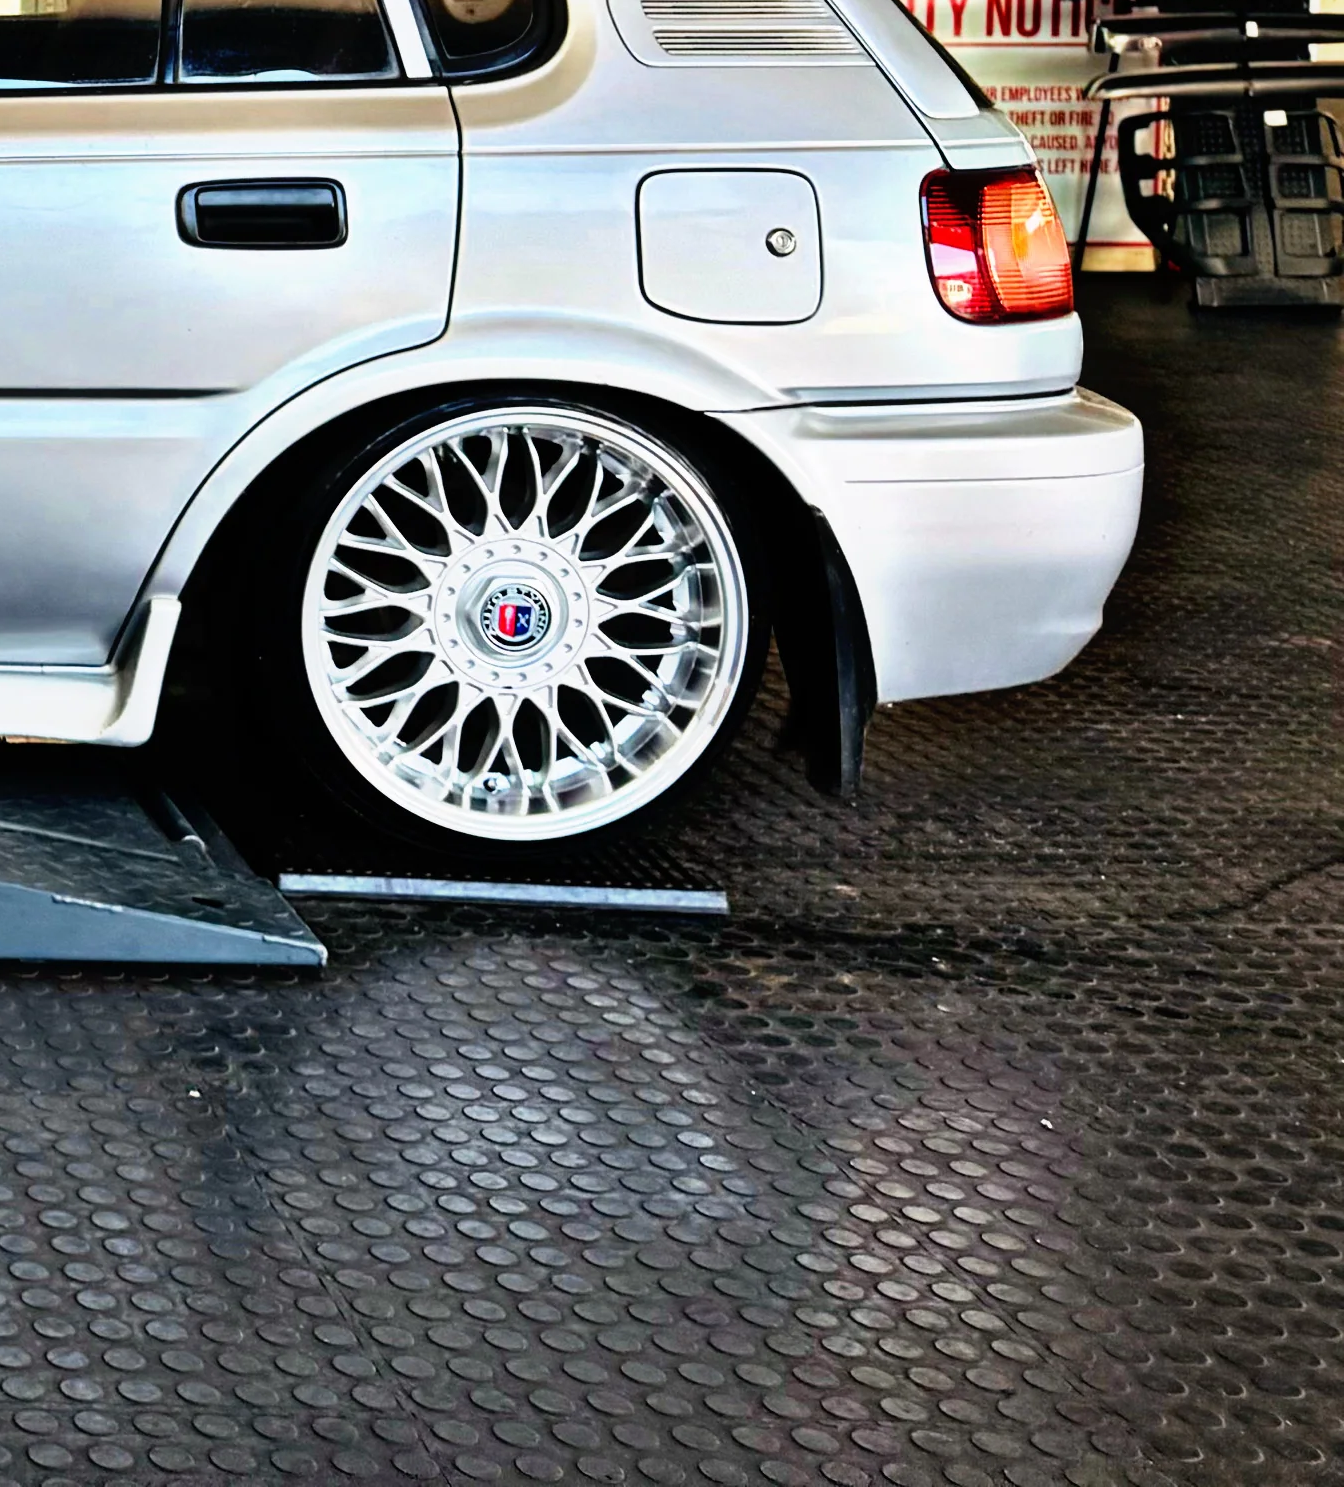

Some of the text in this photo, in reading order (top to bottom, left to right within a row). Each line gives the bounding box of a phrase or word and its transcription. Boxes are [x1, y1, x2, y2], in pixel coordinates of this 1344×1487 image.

[1001, 86, 1071, 102] EMPLOYEES
[1009, 110, 1044, 125] THEFT
[1049, 110, 1066, 126] OR
[1048, 158, 1075, 174] LEFT
[1080, 158, 1111, 174] HRE
